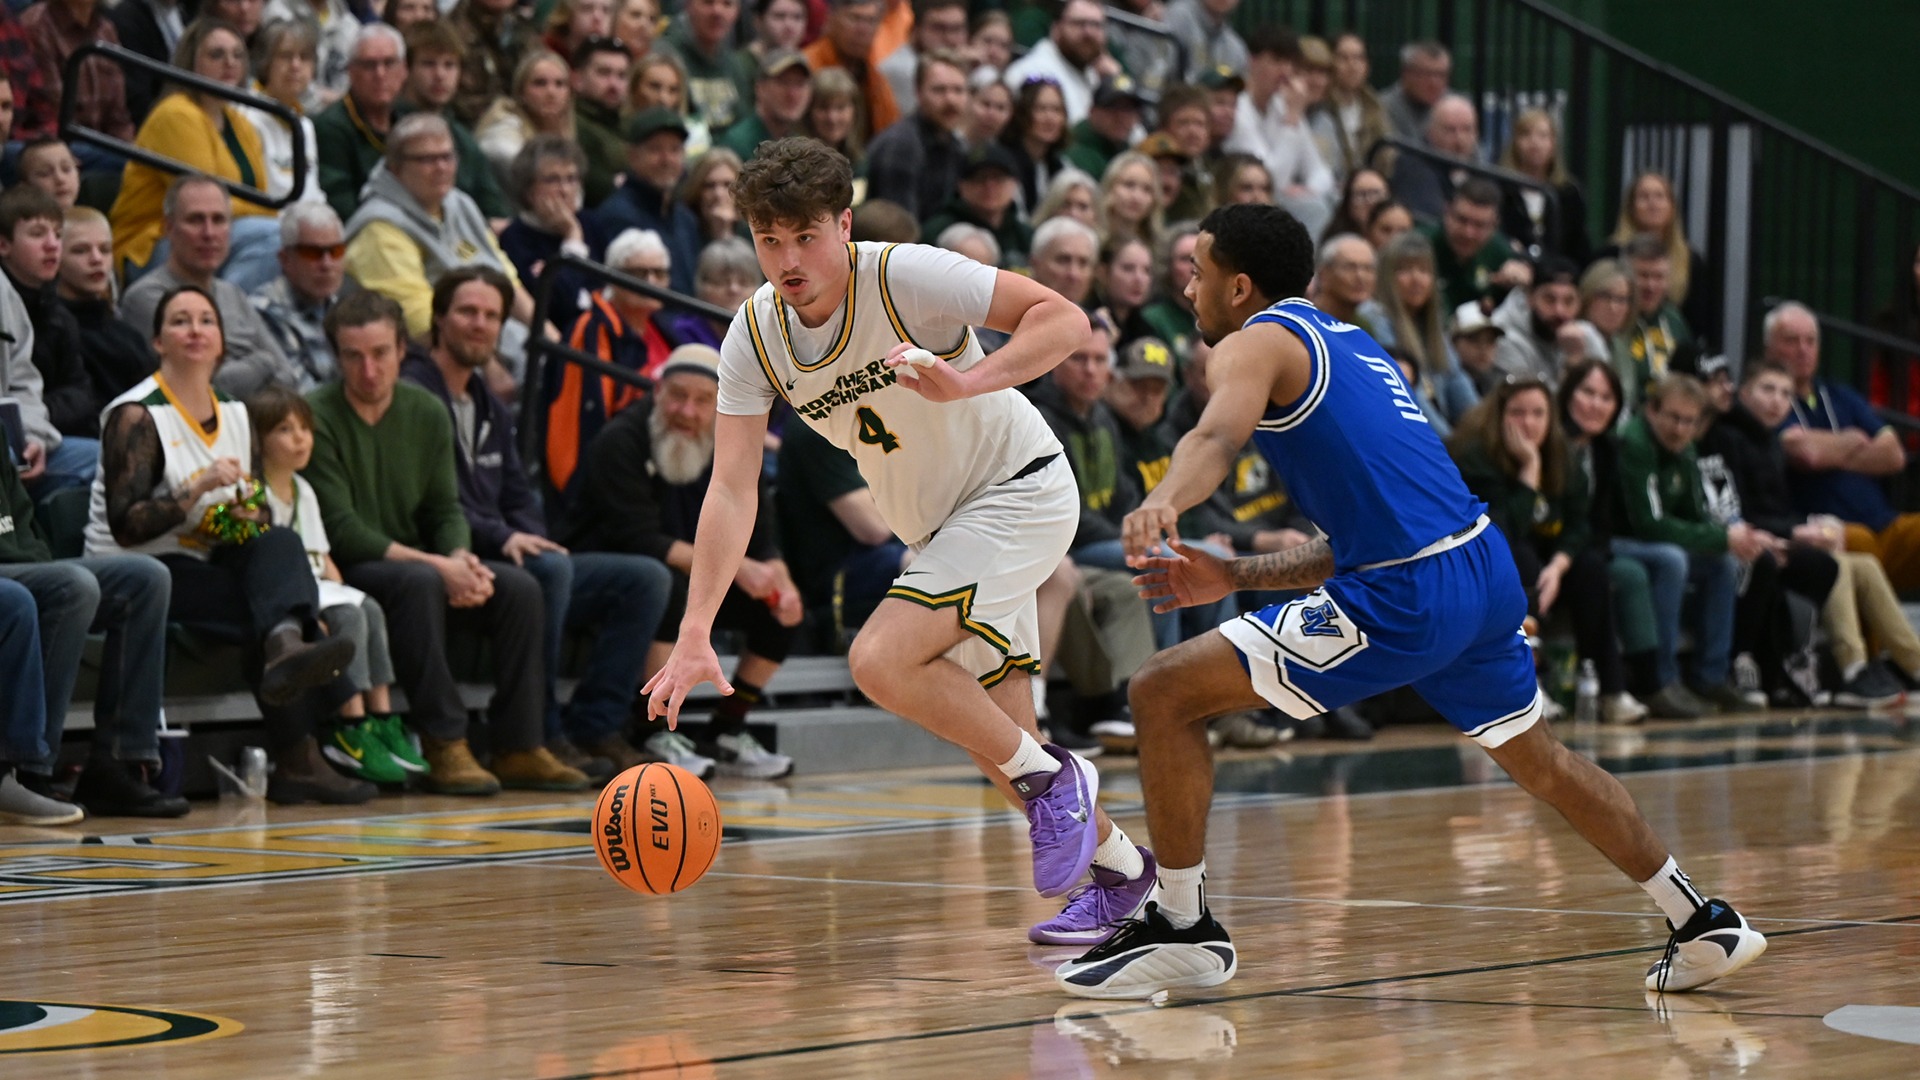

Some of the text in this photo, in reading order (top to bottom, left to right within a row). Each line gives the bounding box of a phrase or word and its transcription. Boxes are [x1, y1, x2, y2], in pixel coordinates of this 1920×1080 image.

[855, 405, 902, 455] 4
[604, 784, 631, 873] Wilson
[650, 798, 669, 851] EVO
